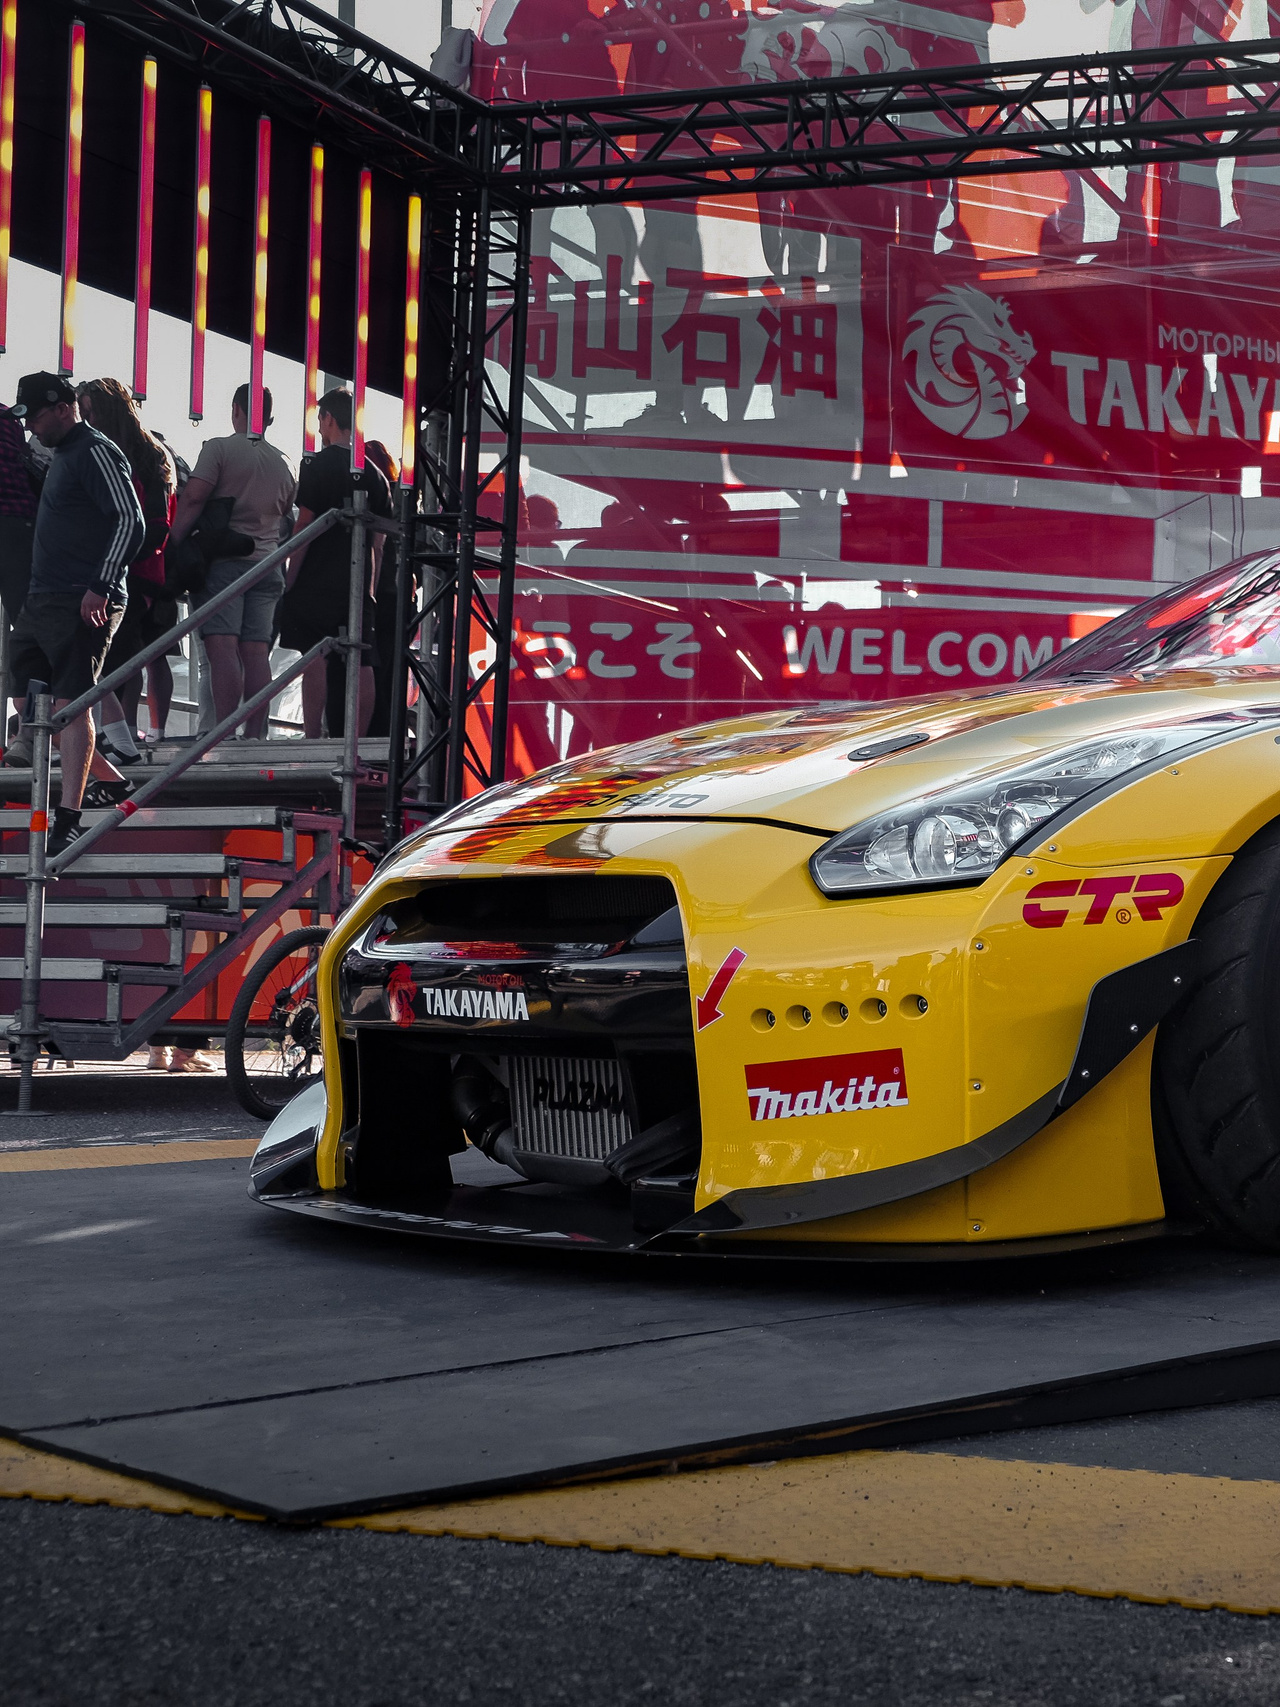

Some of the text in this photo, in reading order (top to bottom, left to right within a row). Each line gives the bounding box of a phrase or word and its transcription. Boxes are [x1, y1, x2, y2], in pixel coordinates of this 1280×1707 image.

[1022, 872, 1185, 930] CTR
[478, 974, 525, 987] MOTOR OIL
[422, 987, 530, 1021] TAKAYAMA
